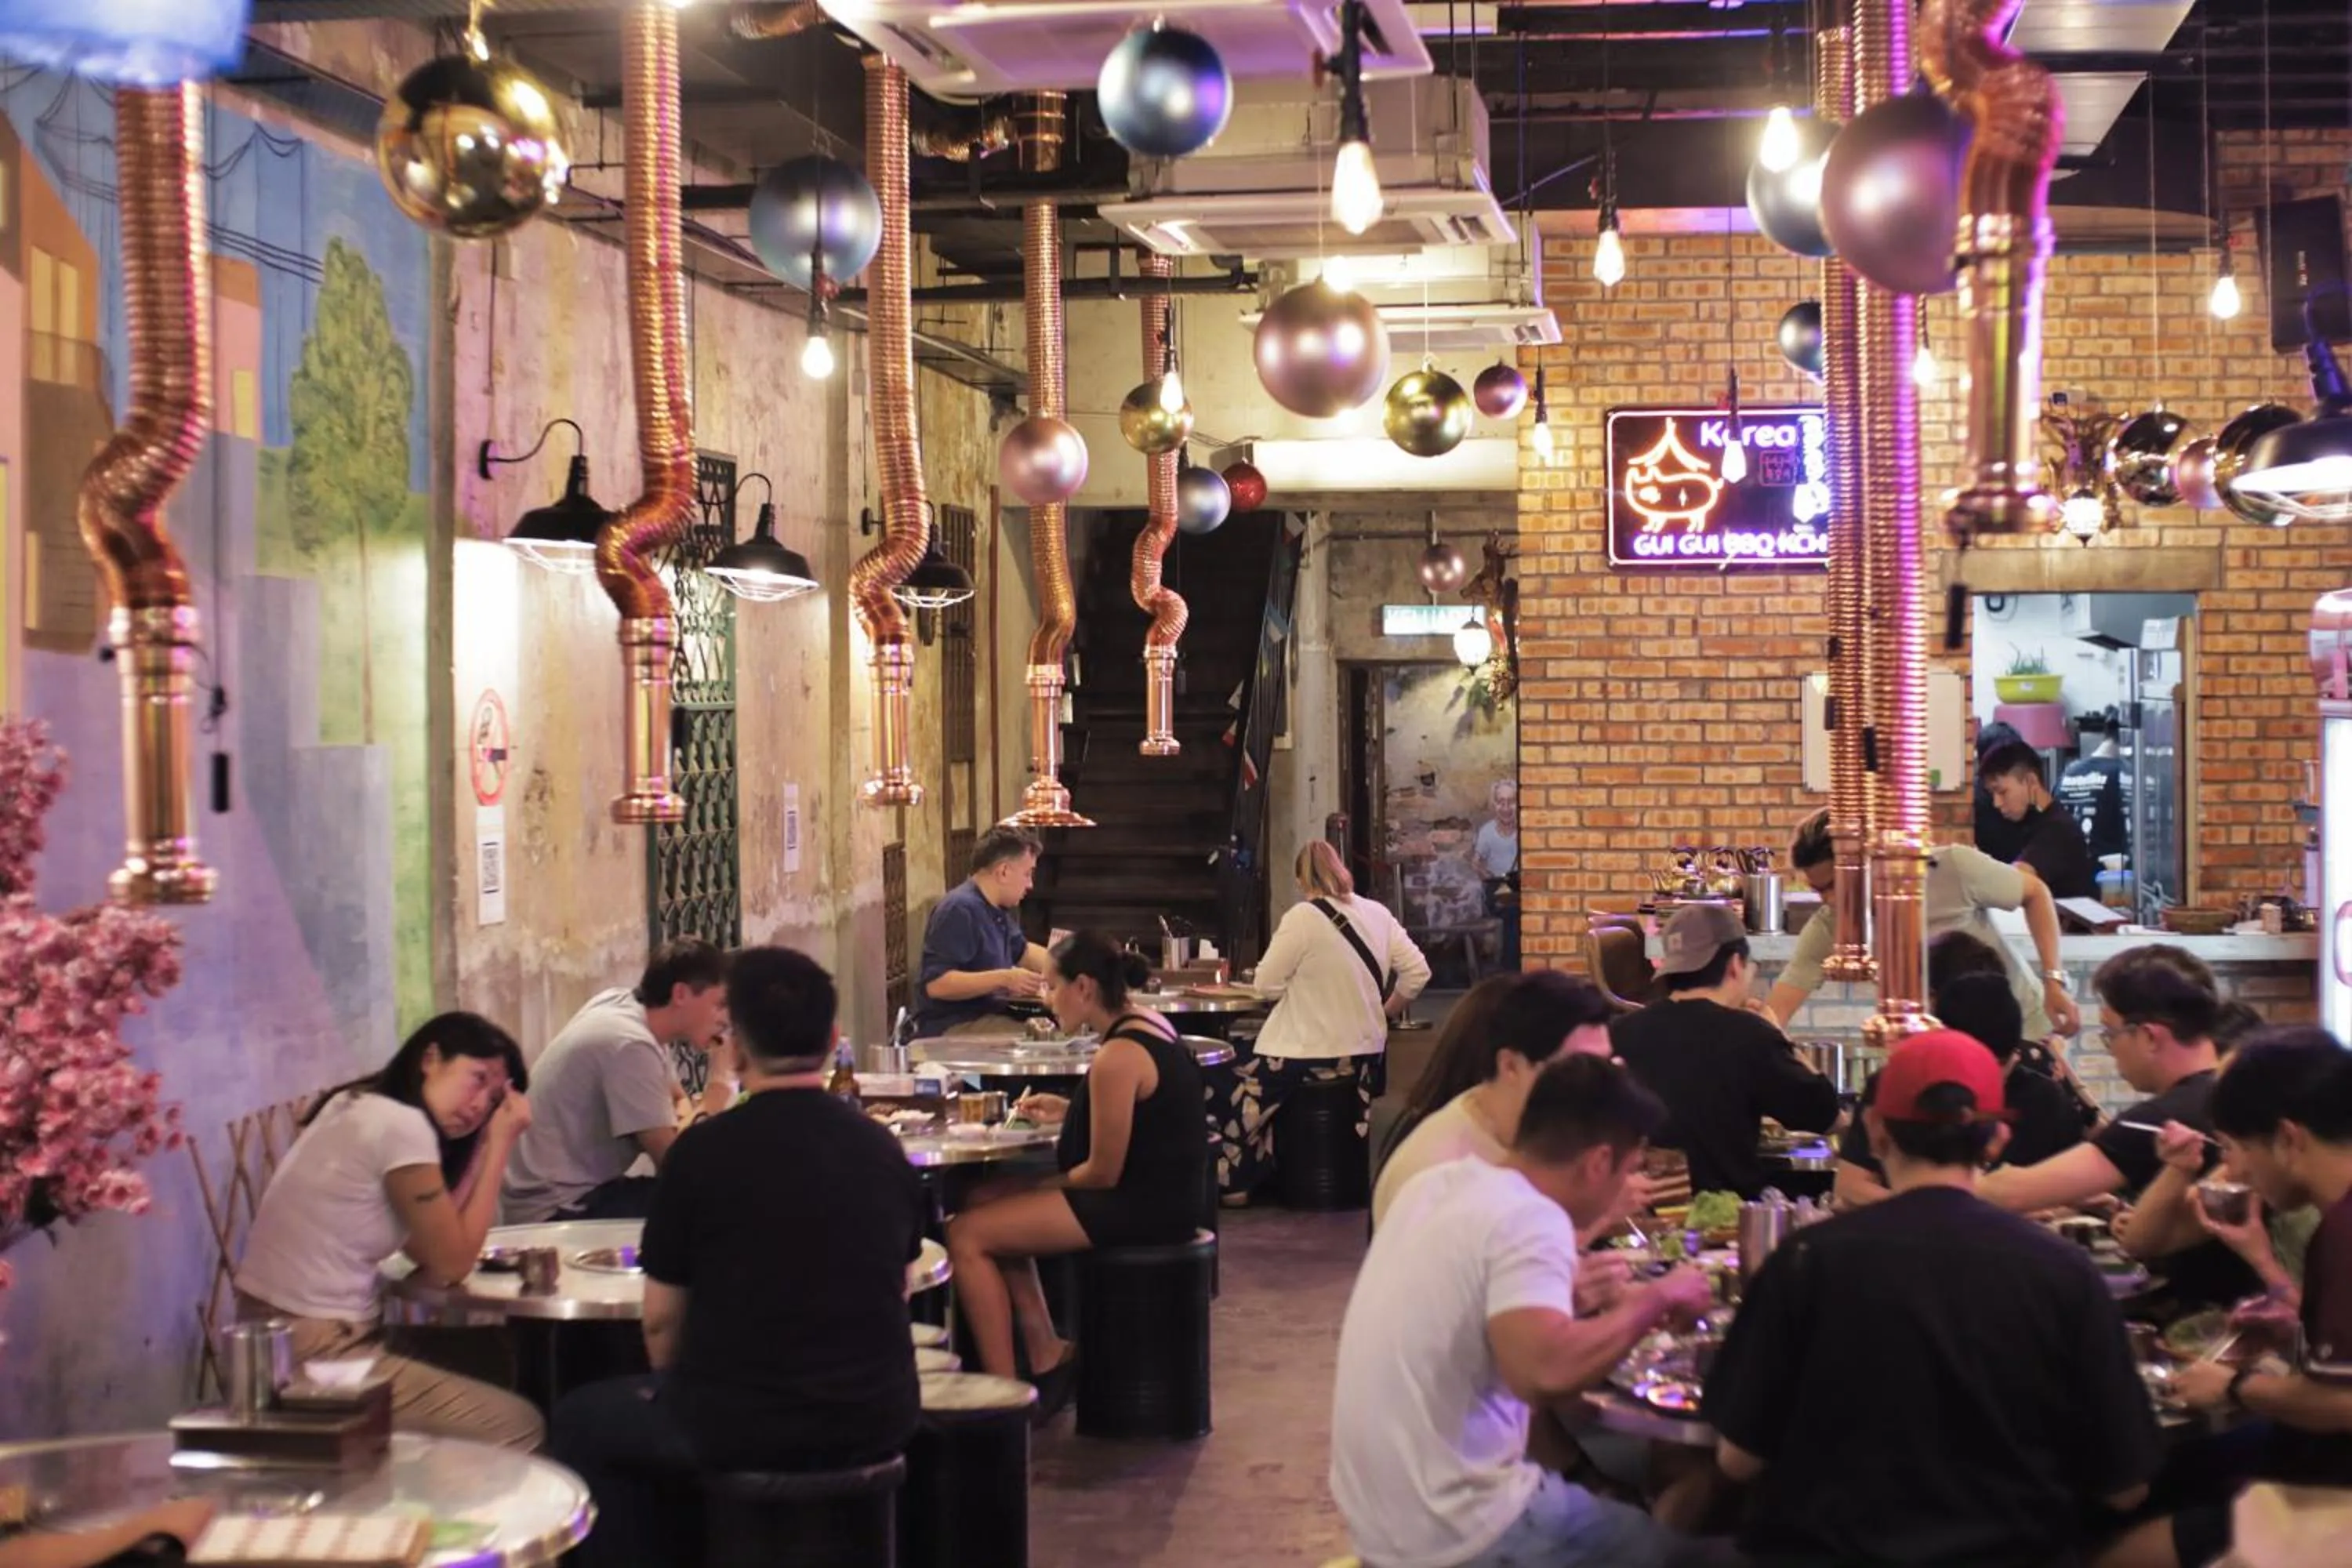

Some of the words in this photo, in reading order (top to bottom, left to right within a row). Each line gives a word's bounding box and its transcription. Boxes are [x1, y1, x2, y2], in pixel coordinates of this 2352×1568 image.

[1700, 421, 1796, 447] Krea
[1634, 534, 1674, 555] GUI
[1679, 534, 1719, 554] GUI
[1723, 533, 1776, 557] BBQ
